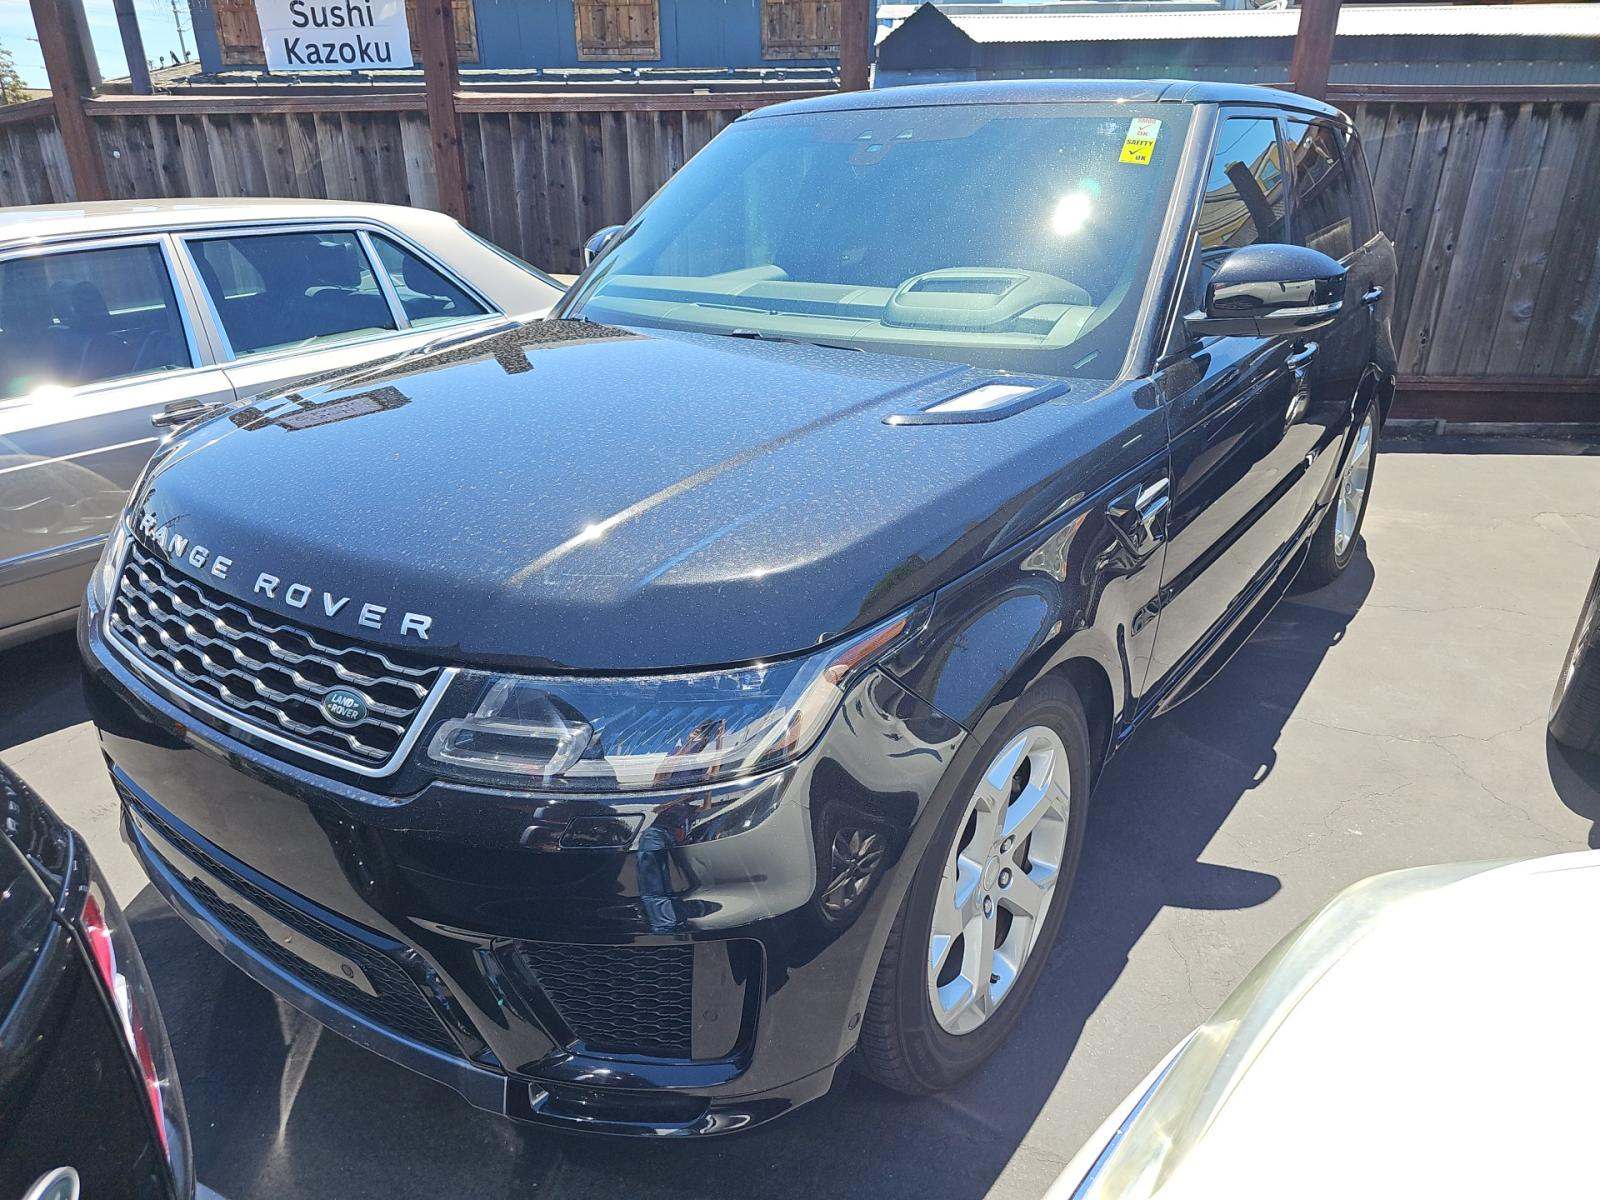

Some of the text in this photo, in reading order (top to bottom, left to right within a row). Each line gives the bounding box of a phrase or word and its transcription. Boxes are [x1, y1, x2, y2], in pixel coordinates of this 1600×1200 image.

[289, 0, 374, 28] Sushi
[284, 35, 392, 64] Kazoku
[140, 513, 432, 640] RANGE ROVER
[330, 703, 359, 719] ROVER
[331, 693, 355, 708] LAND
